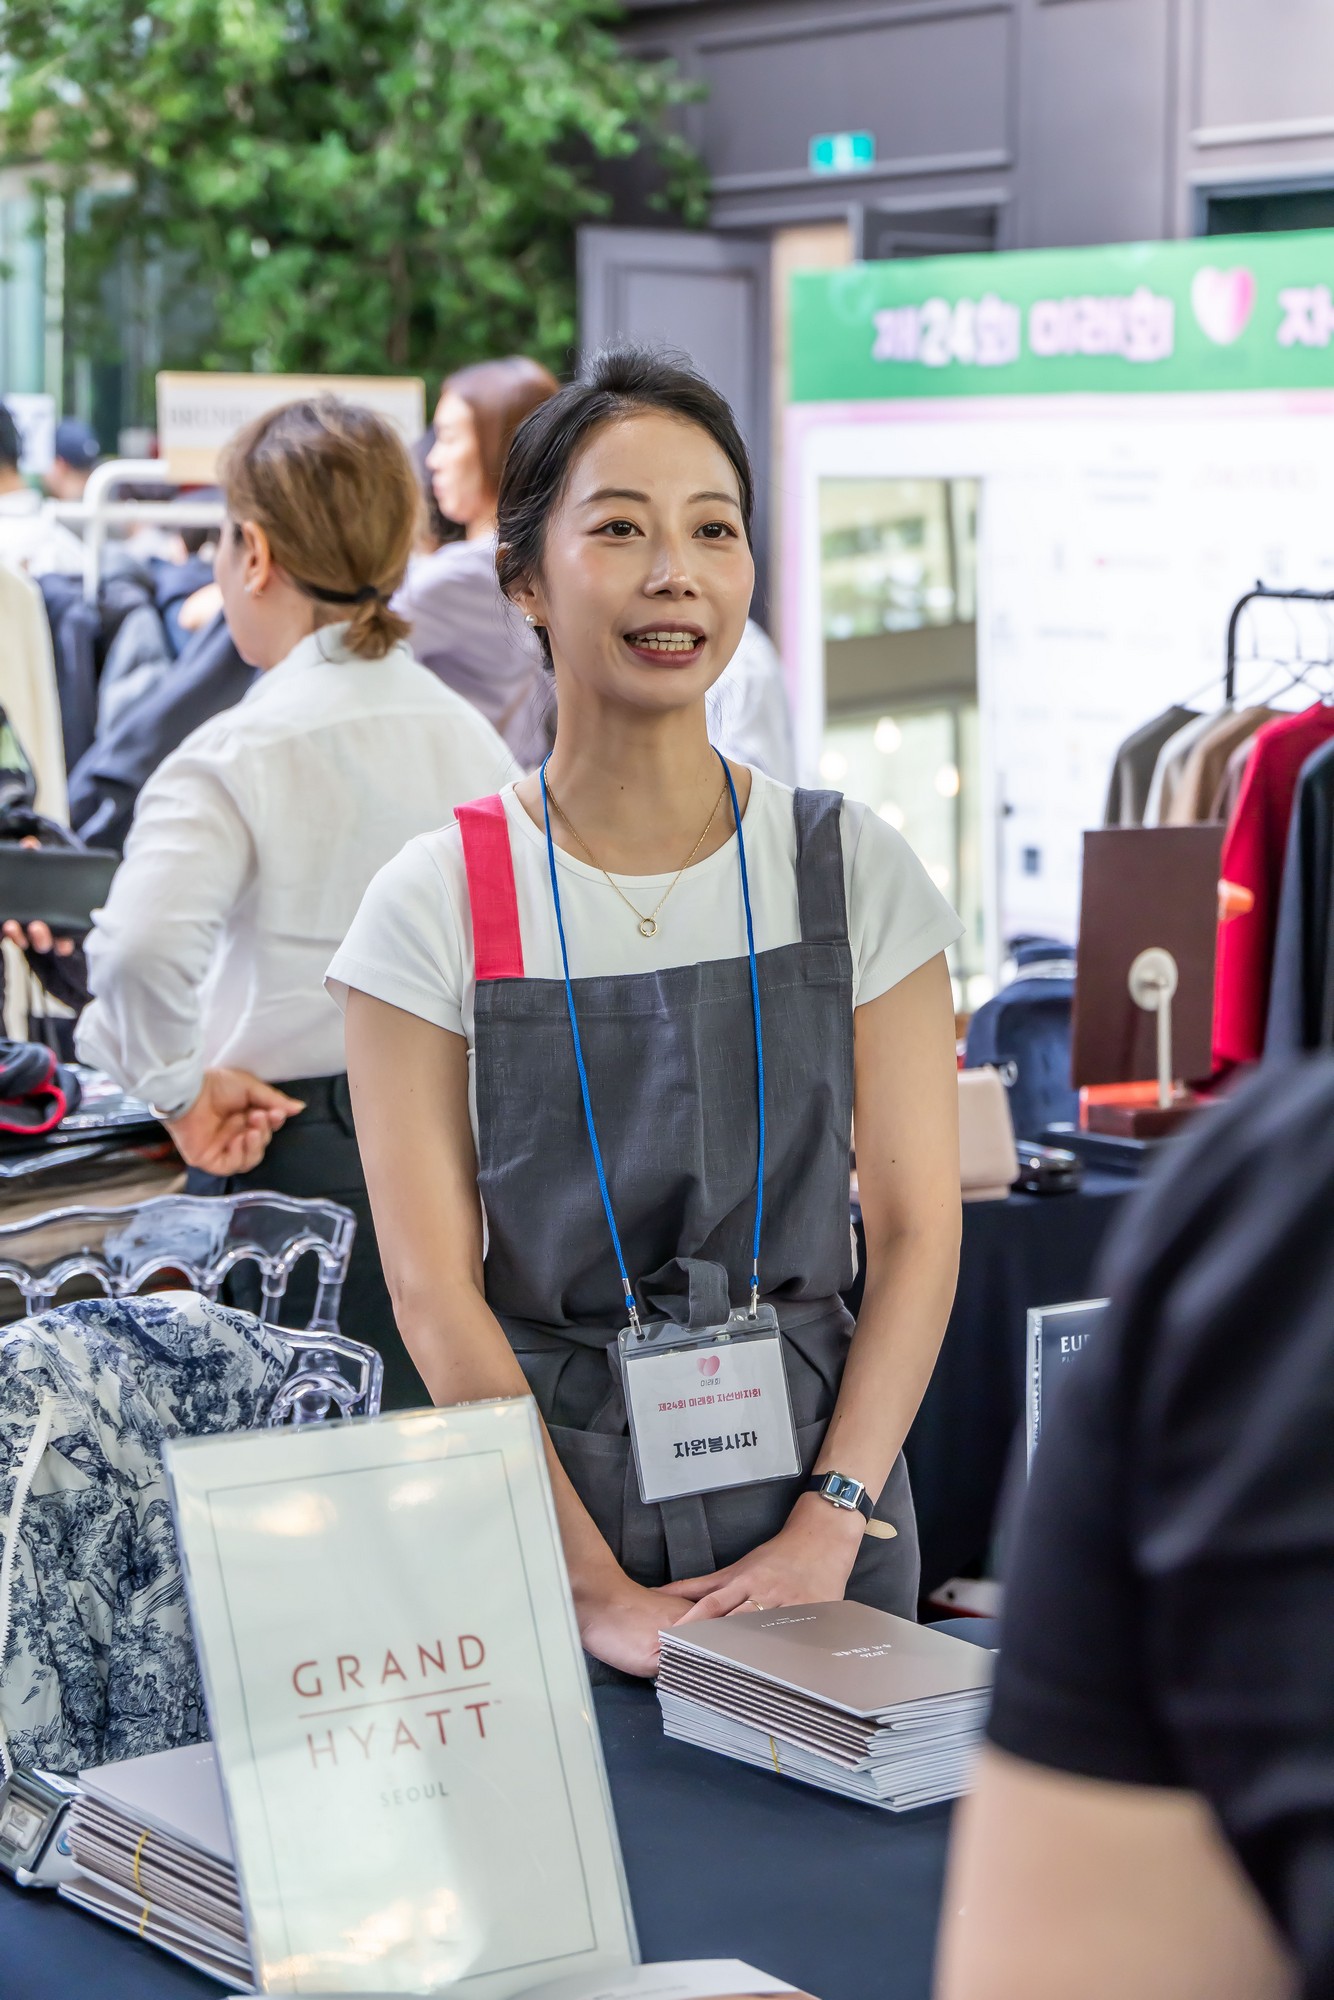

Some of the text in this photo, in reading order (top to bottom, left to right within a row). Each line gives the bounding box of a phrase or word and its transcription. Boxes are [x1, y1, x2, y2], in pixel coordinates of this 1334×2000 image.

[872, 293, 1020, 367] 제24회
[1029, 286, 1174, 363] 미래회
[700, 1378, 721, 1387] 미래회
[658, 1388, 761, 1412] 제24회 미래회 자선바자회
[673, 1430, 758, 1459] 자원봉사자
[293, 1634, 485, 1697] GRAND
[307, 1701, 490, 1769] HYATT
[380, 1781, 449, 1808] SEOUL
